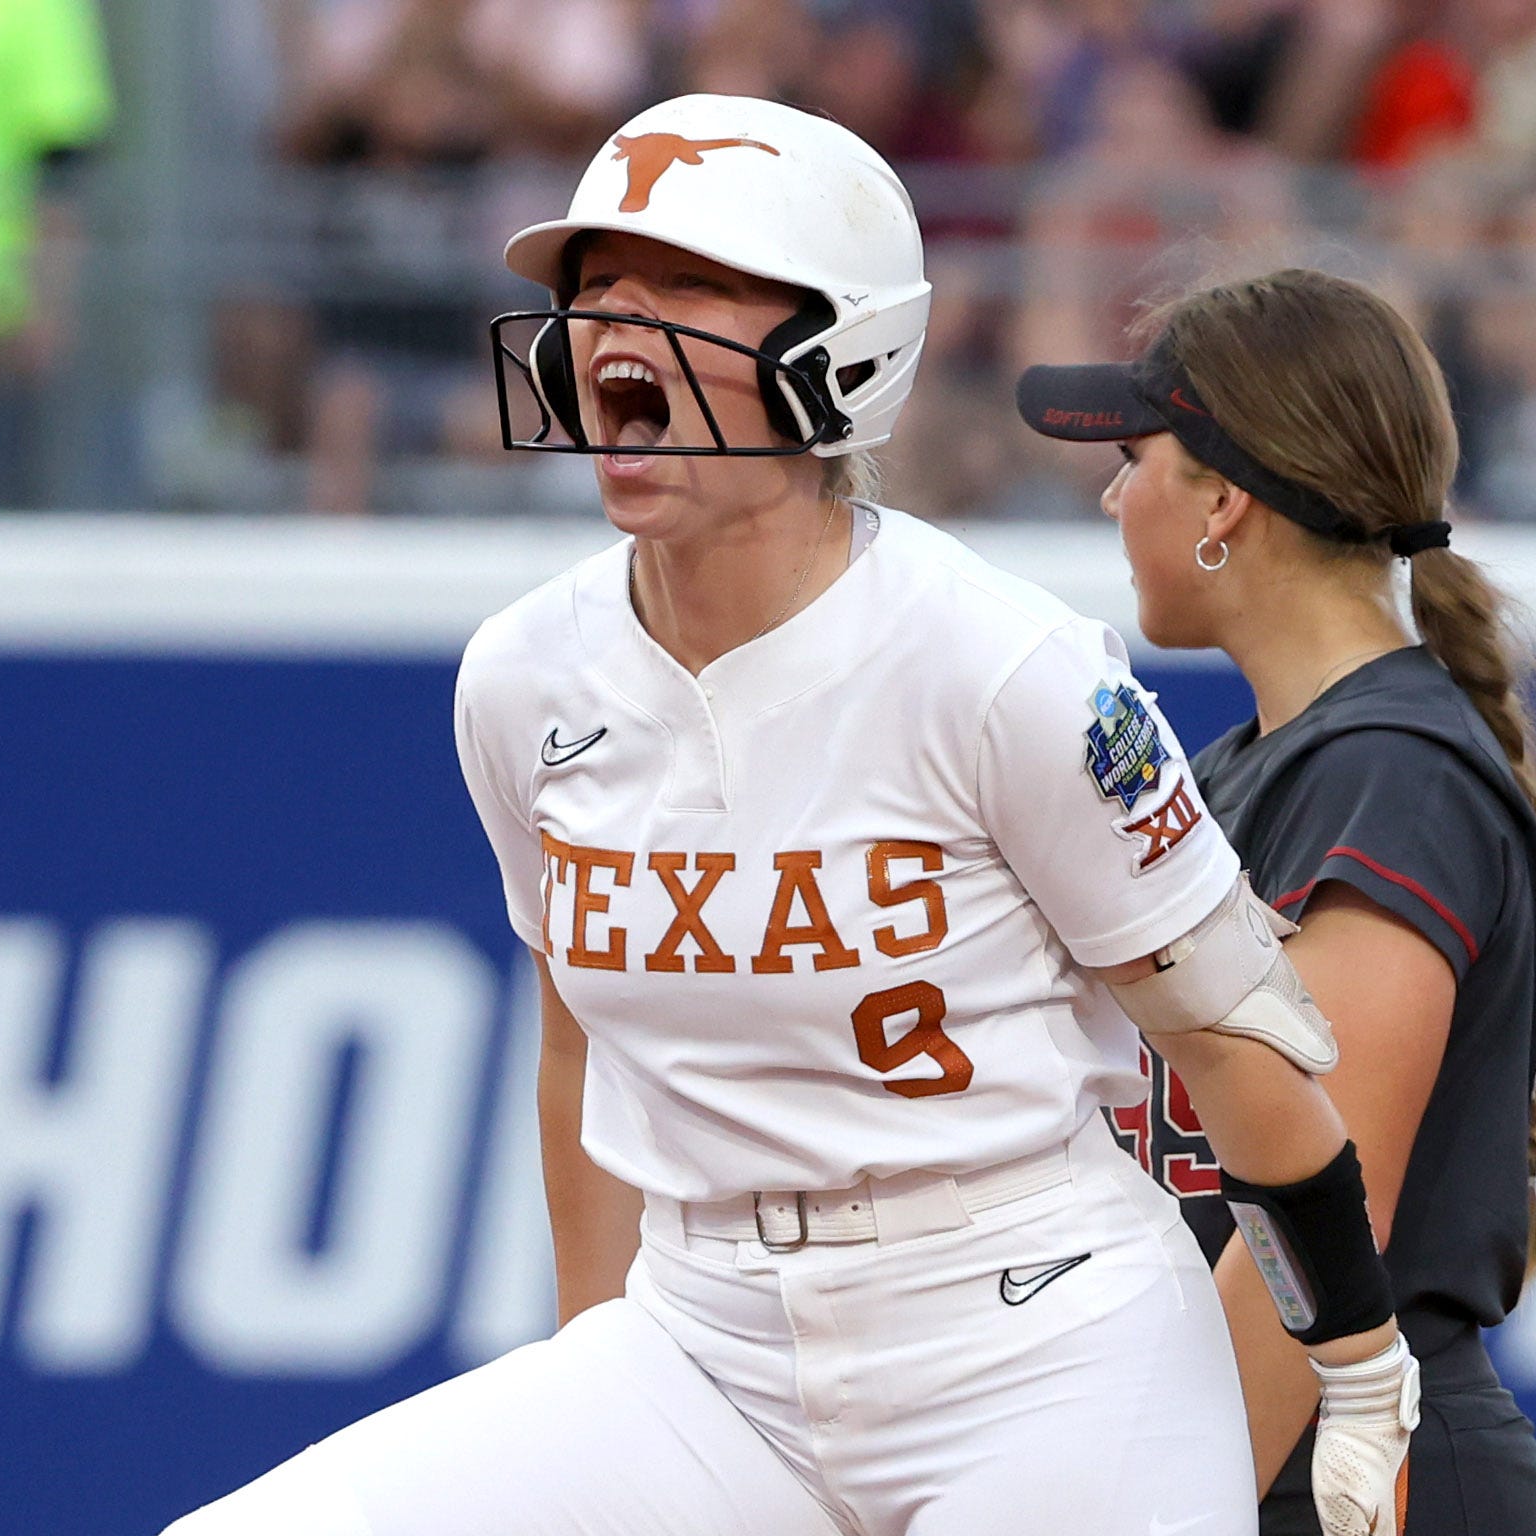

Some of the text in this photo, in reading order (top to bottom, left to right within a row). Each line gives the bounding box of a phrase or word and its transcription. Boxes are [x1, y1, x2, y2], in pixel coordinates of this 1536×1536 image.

[1041, 407, 1124, 427] SOFTBALL
[1101, 748, 1139, 792] WORLD
[1133, 715, 1154, 757] SERIES
[1109, 713, 1142, 764] COLLEGE
[540, 831, 949, 974] TEXAS
